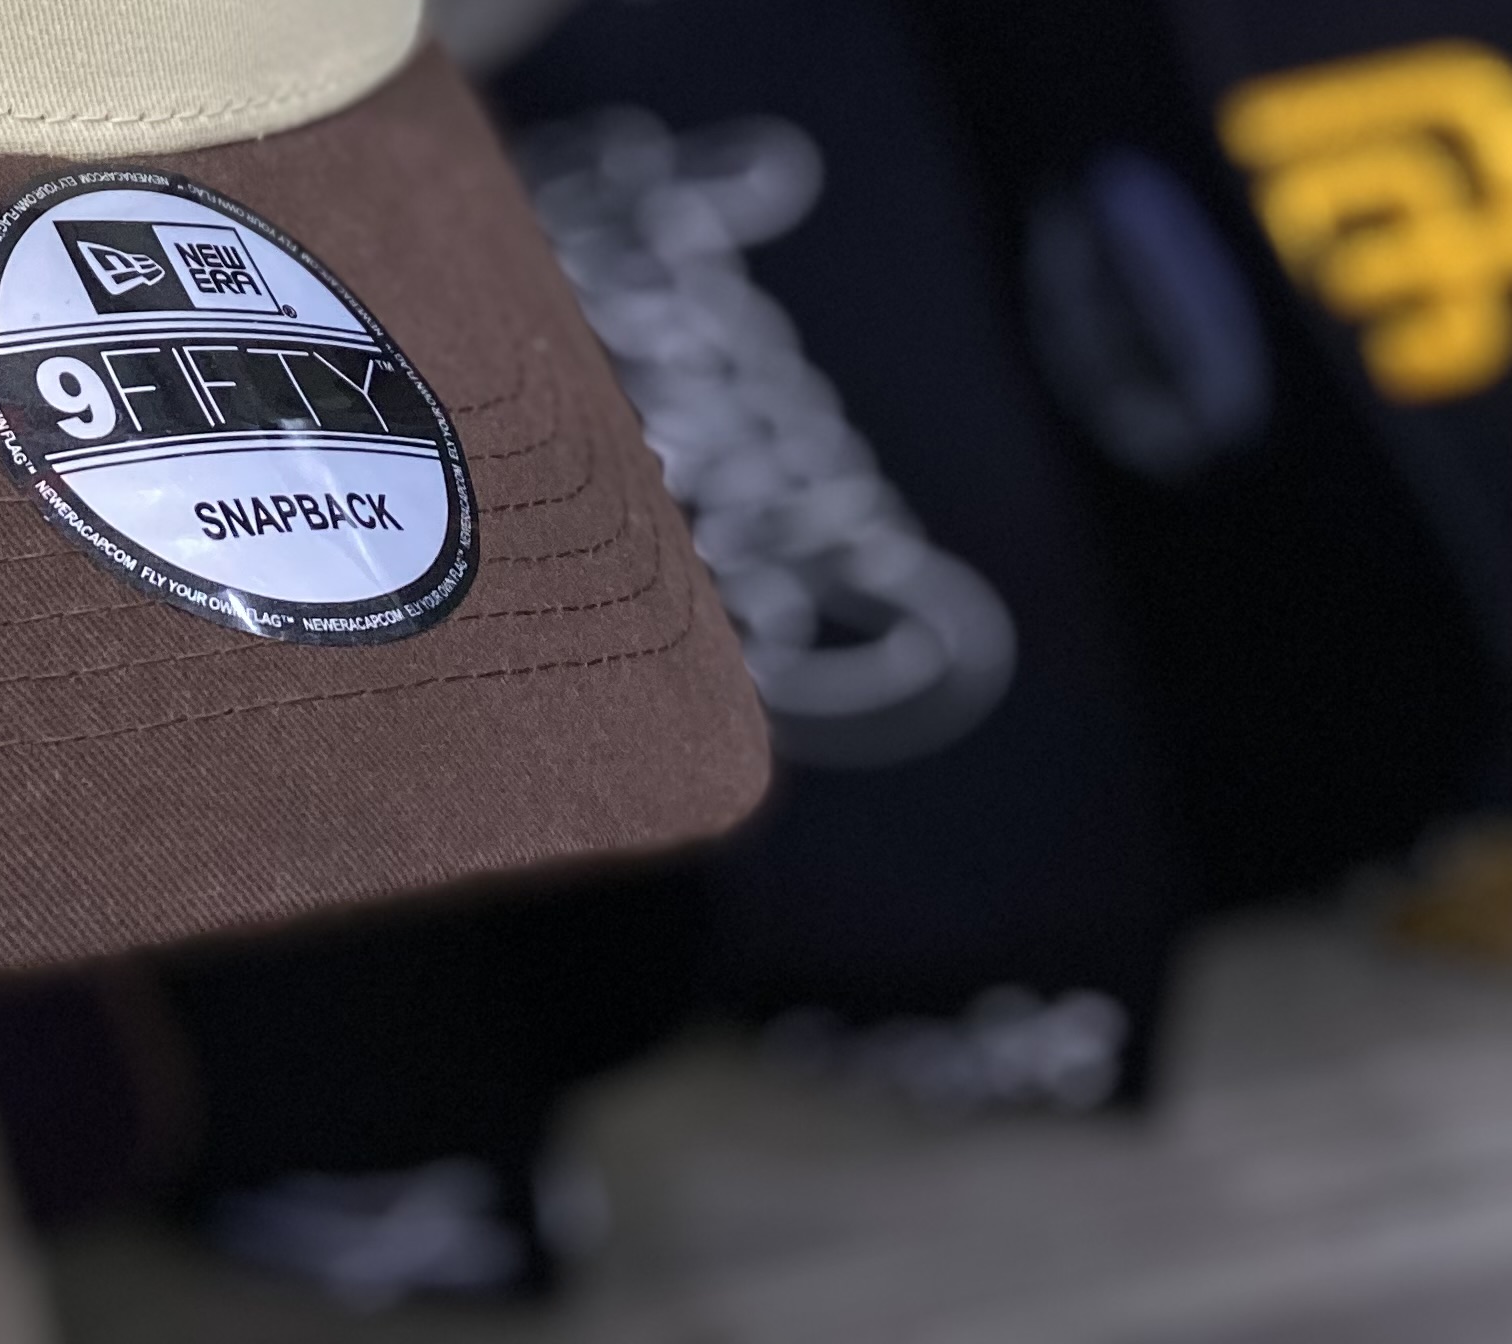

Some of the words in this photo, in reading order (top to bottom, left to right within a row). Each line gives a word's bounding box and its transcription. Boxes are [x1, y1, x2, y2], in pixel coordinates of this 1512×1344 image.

[174, 242, 247, 269] NEW
[189, 269, 263, 296] ERA
[193, 491, 404, 541] SNAPBACK
[140, 565, 168, 588] FLY
[168, 578, 208, 607] YOUR
